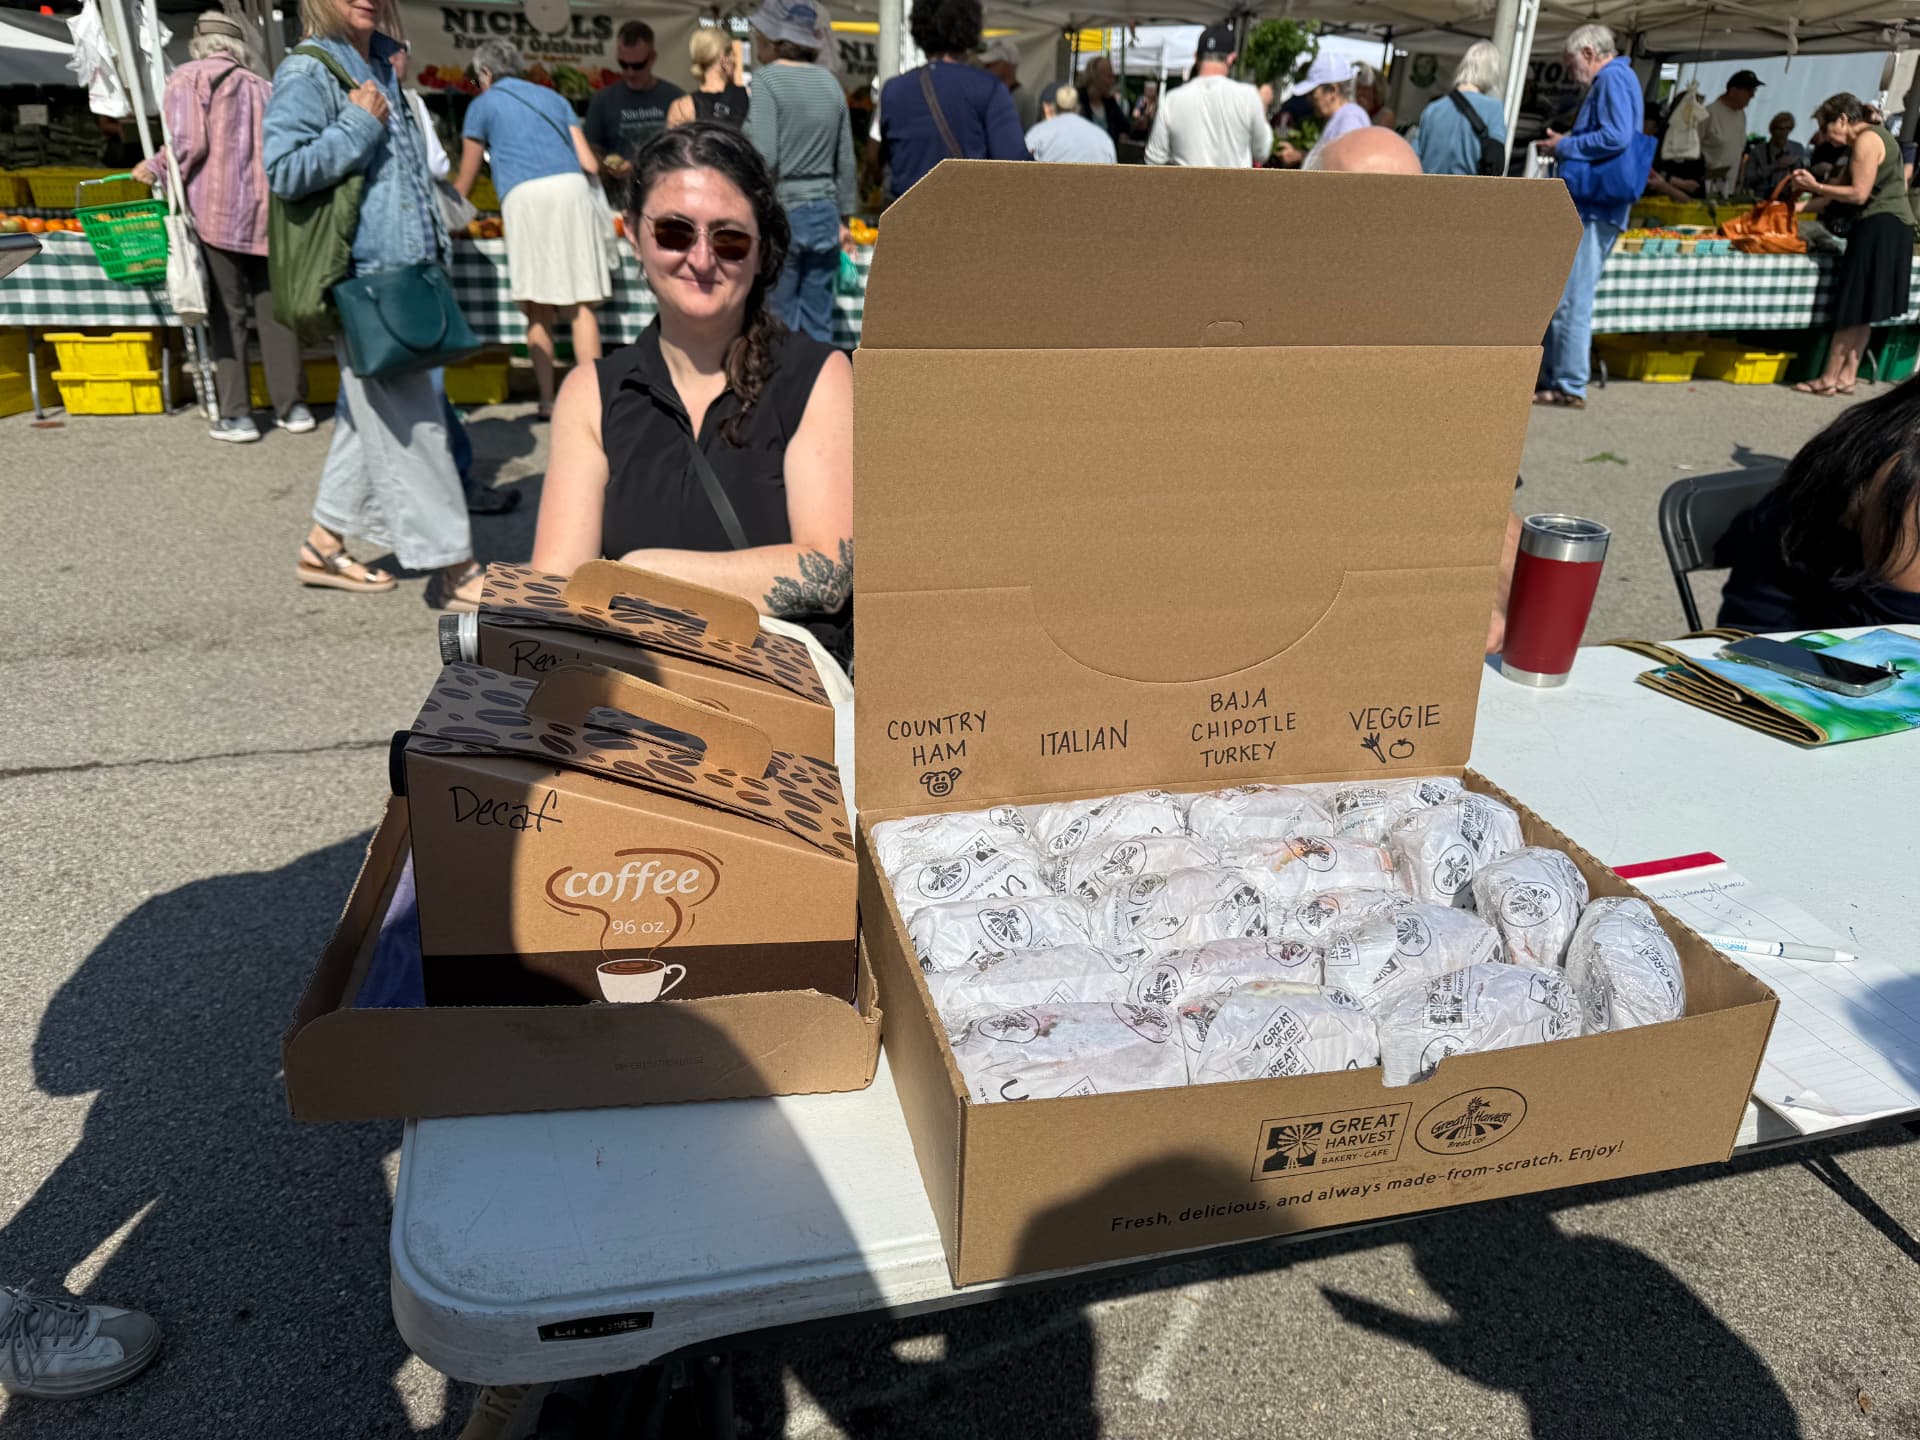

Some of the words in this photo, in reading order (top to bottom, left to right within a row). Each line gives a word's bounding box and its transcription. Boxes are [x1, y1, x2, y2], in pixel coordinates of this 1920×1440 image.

[441, 6, 613, 40] NICHLS
[530, 37, 604, 55] Orchard
[1210, 687, 1267, 713] BAJA
[887, 710, 987, 741] COUNTRY
[1191, 712, 1297, 742] CHIPOTLE
[1349, 704, 1441, 731] VEGGIE
[1041, 719, 1129, 757] ITALIAN
[912, 739, 967, 767] HAM
[1200, 741, 1277, 768] TURKEY
[449, 786, 563, 832] Decaf
[564, 860, 700, 903] coffee
[612, 920, 636, 935] 96
[641, 919, 671, 934] oz.
[1262, 1012, 1293, 1046] GREAT
[1329, 1112, 1400, 1135] GREAT
[1431, 1114, 1467, 1134] Great
[1474, 1110, 1512, 1124] Harvest
[1325, 1130, 1396, 1149] HARVEST
[1111, 1213, 1171, 1231] Fresh,
[1178, 1201, 1270, 1223] delicious,
[1277, 1192, 1312, 1208] and
[1317, 1183, 1381, 1202] always
[1387, 1154, 1563, 1190] made-from-scratch.
[1568, 1140, 1625, 1163] Enjoy!
